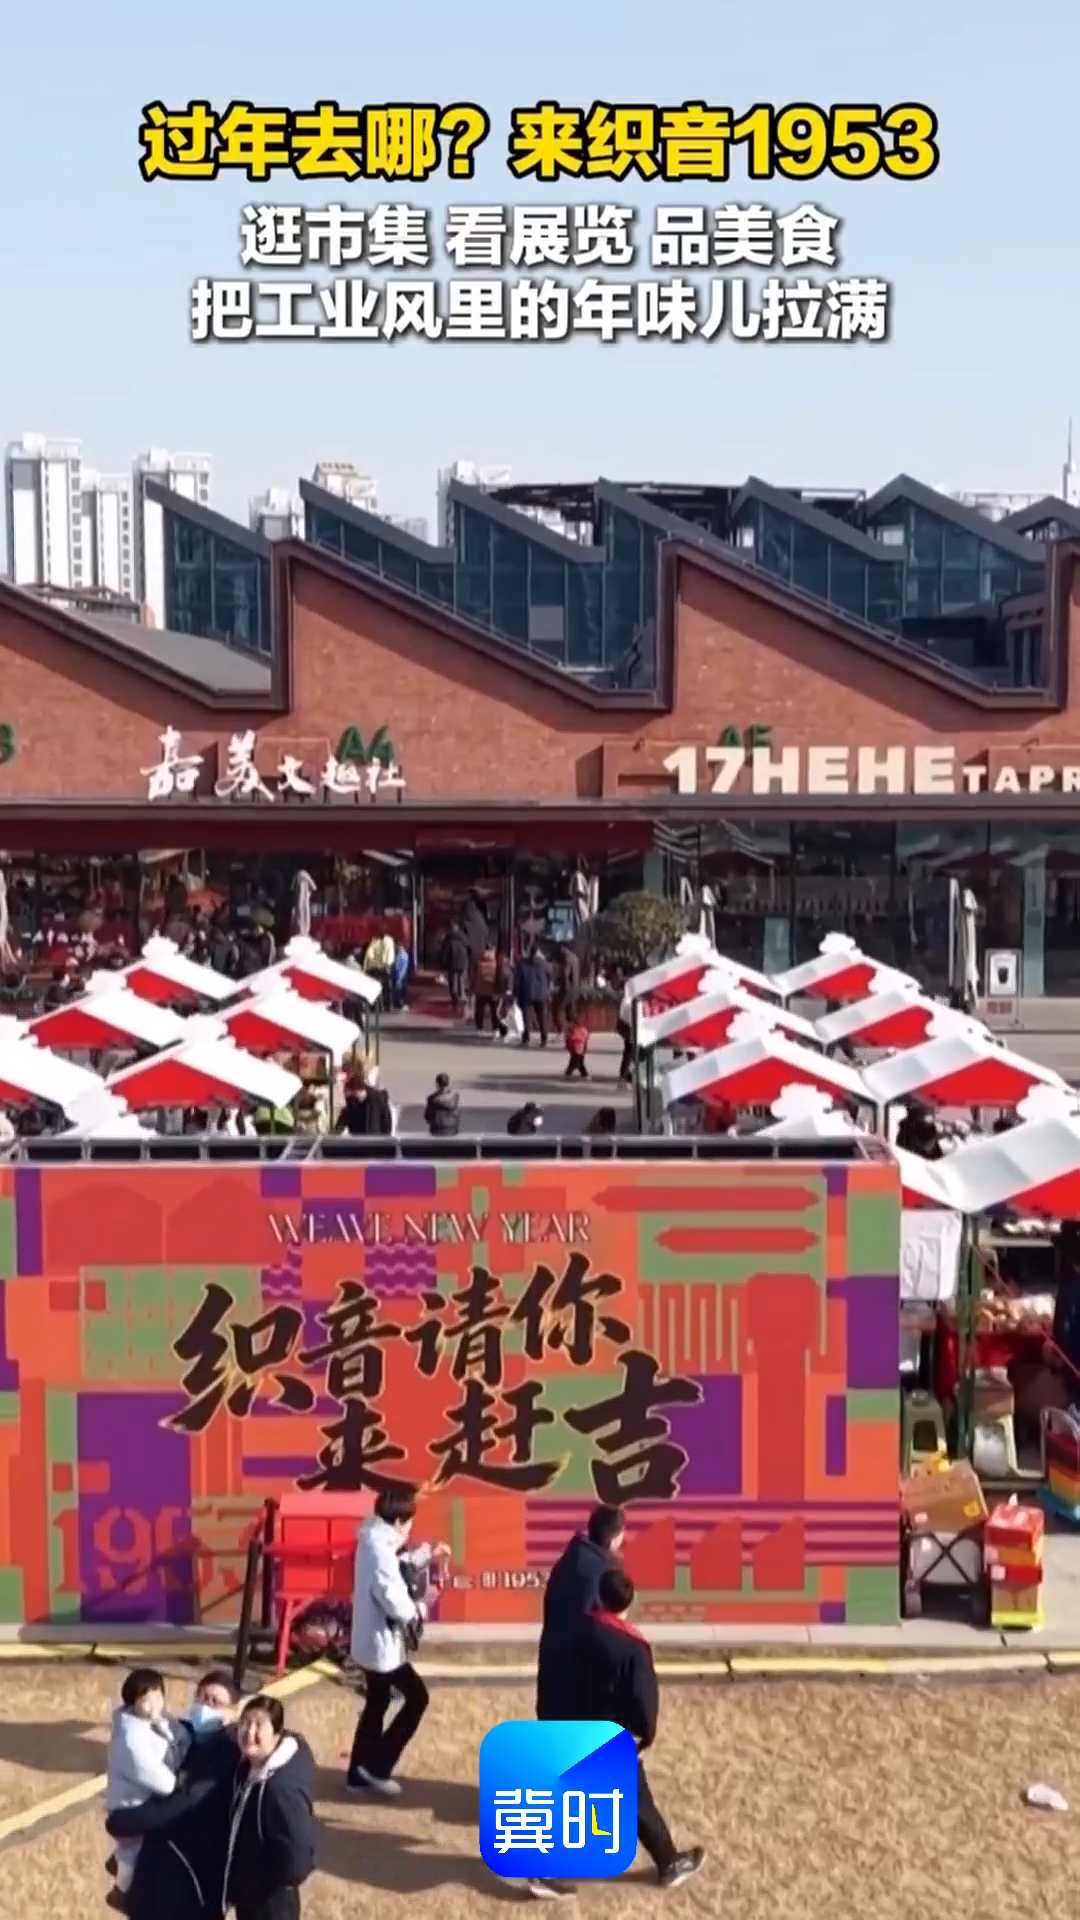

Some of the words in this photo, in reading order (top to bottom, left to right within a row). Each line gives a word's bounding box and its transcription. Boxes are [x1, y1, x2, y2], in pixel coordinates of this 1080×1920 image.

[663, 746, 956, 794] 17HEHE
[403, 1212, 488, 1241] NEW
[500, 1212, 591, 1241] YEAR
[161, 1252, 632, 1432] 织音请你
